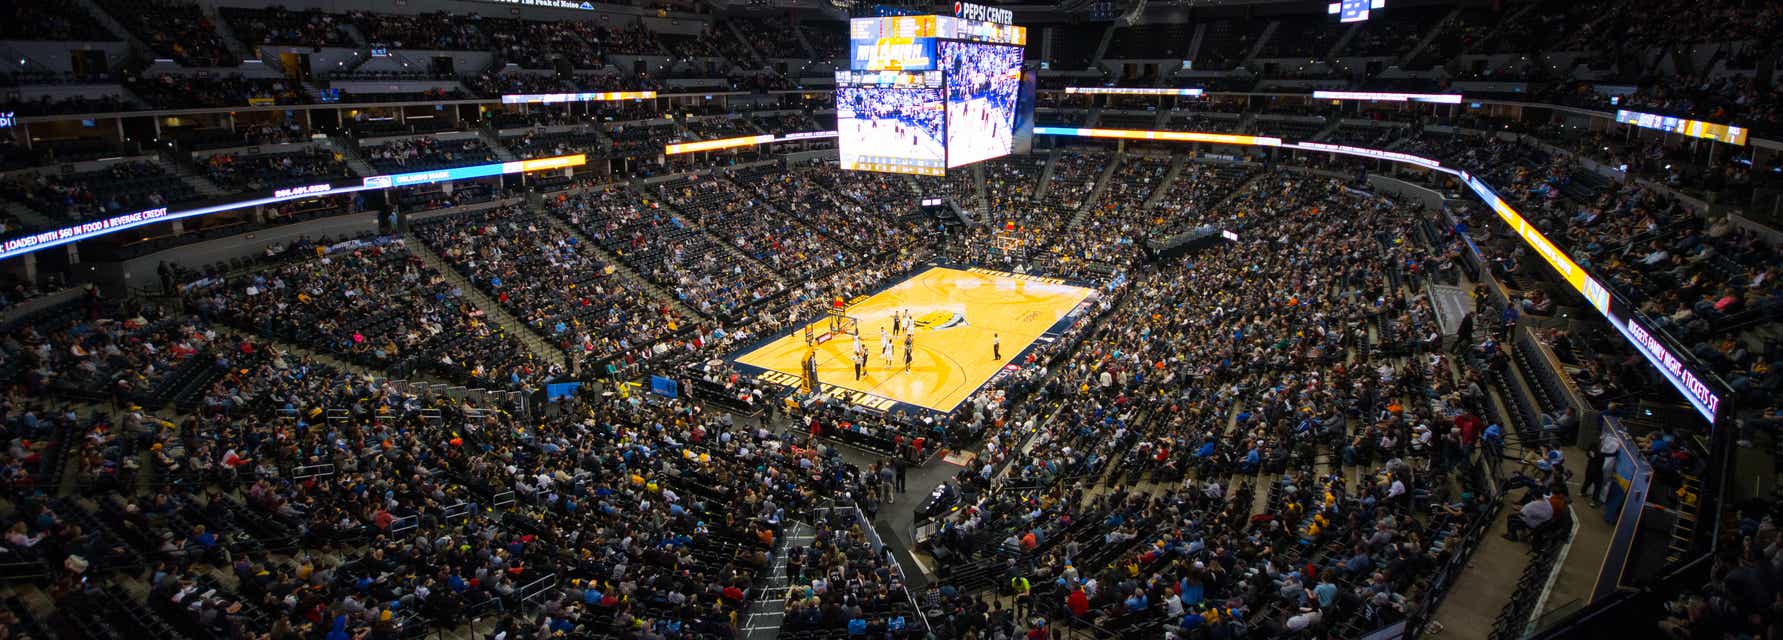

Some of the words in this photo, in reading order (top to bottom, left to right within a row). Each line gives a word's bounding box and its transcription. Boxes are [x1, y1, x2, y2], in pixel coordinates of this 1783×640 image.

[963, 2, 986, 21] PEPSI
[987, 7, 1013, 25] CENTER
[4, 235, 38, 251] LOADED
[38, 230, 58, 244] WITH
[58, 227, 74, 239] $60
[74, 225, 82, 236] IN
[83, 221, 102, 234] FOOD
[103, 219, 110, 229] &
[110, 211, 142, 227] BEVERAGE
[142, 207, 168, 220] CREDIT
[1627, 318, 1649, 346] NUGGETS
[1648, 334, 1666, 361] FAMILY
[1686, 370, 1710, 405] TICKETS
[1707, 393, 1719, 413] ST
